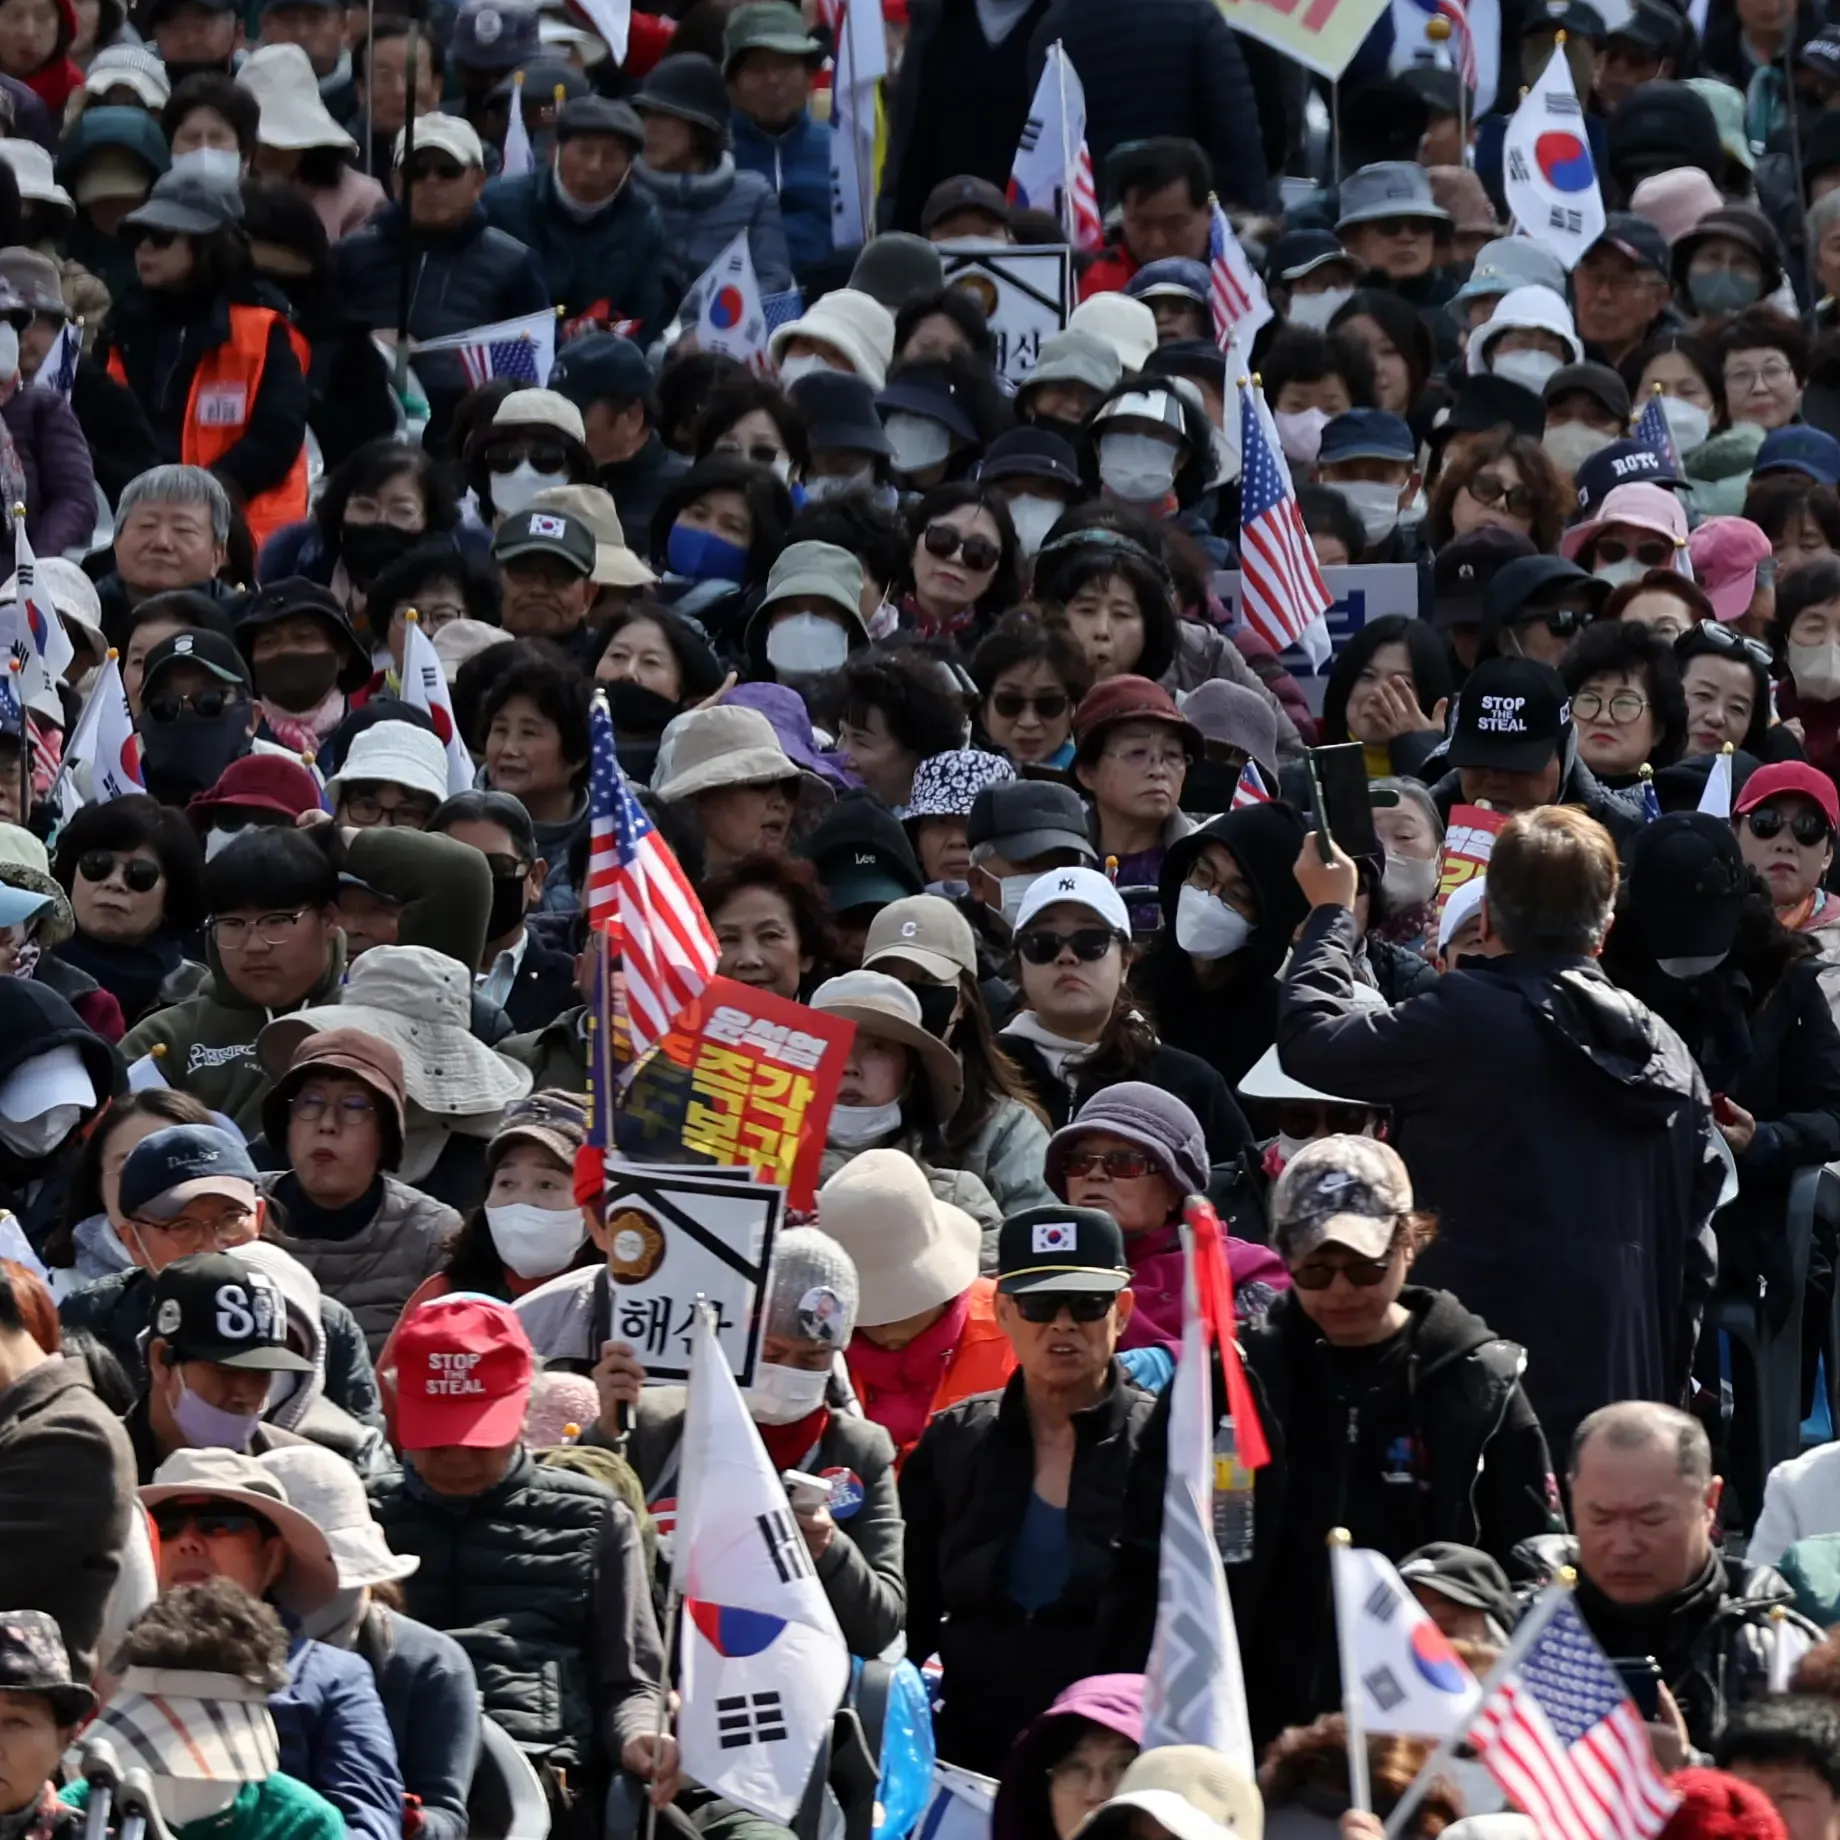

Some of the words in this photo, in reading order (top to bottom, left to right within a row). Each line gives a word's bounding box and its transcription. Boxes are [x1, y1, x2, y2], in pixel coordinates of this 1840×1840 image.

[1611, 452, 1659, 477] ROTC
[1482, 695, 1526, 711] STOP
[1492, 709, 1513, 720] THE
[1478, 717, 1527, 731] STEAL
[855, 852, 876, 864] Lee
[703, 1005, 828, 1070] 윤석열
[692, 1043, 815, 1122] 즉각
[429, 1353, 481, 1370] STOP
[443, 1369, 467, 1380] THE
[426, 1379, 486, 1394] STEAL
